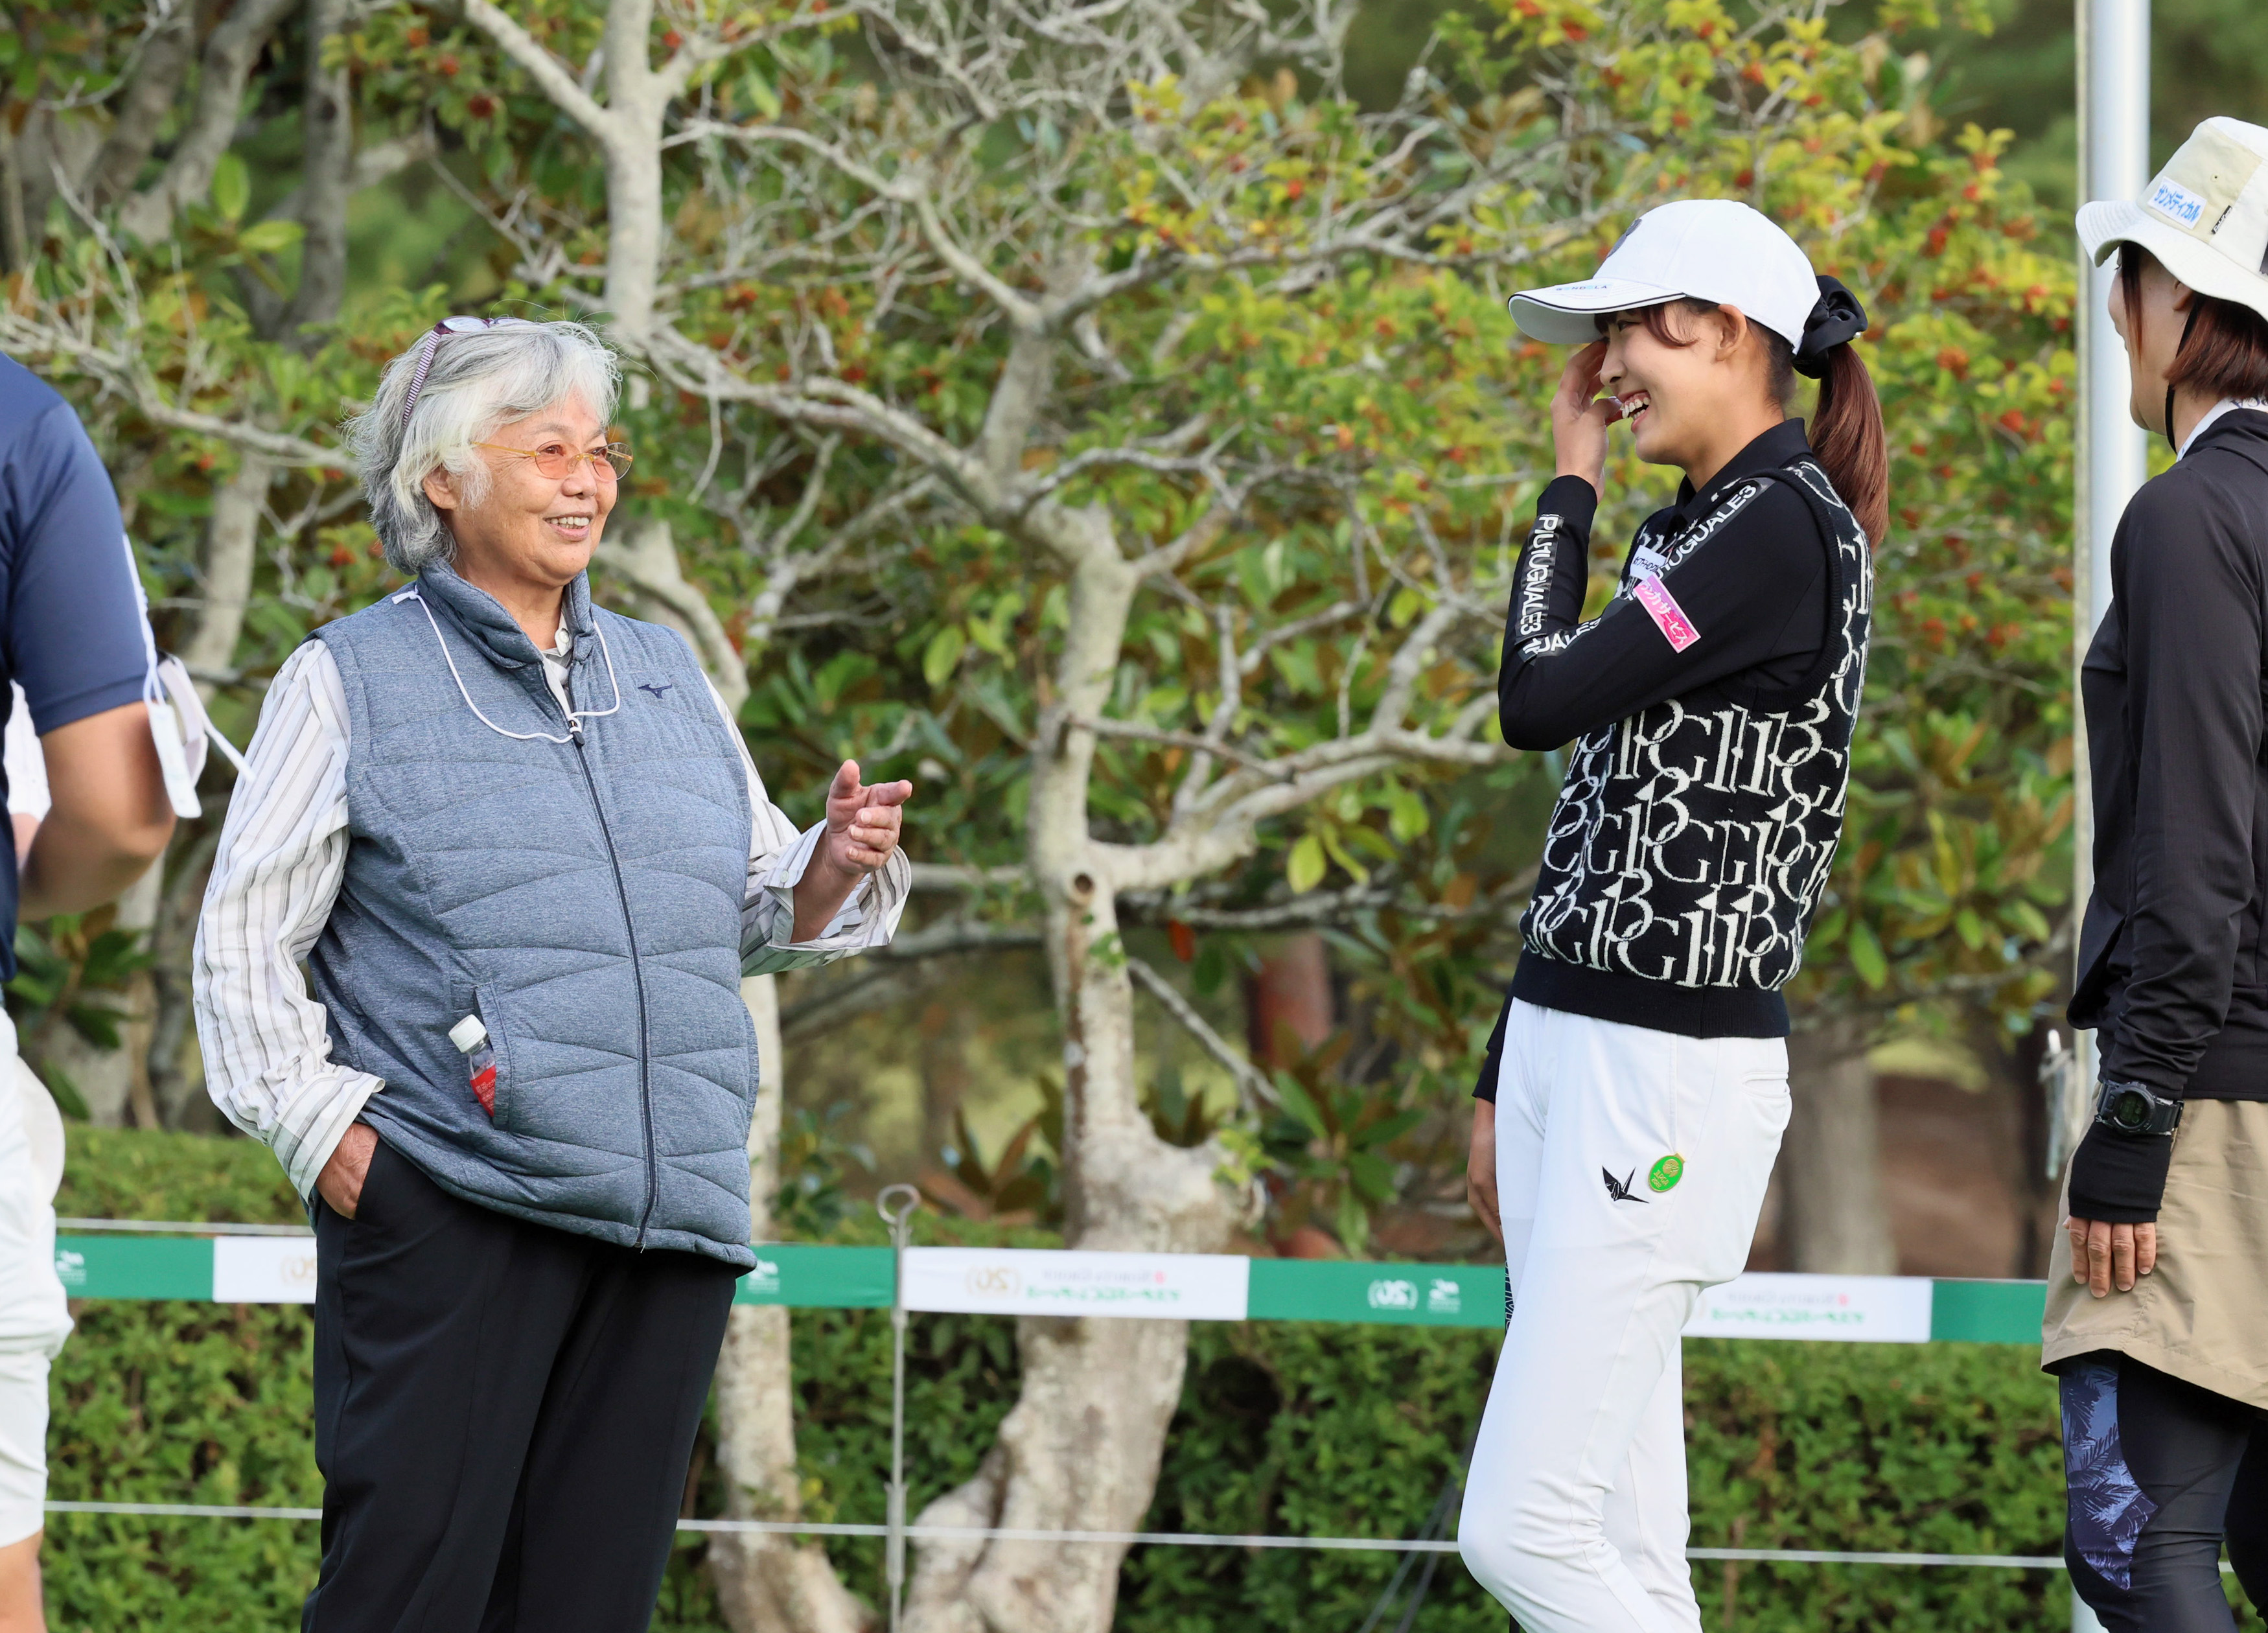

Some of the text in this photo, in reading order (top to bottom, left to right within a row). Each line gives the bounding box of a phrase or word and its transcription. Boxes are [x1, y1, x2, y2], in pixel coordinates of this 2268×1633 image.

[2155, 185, 2201, 222] サンメディカル
